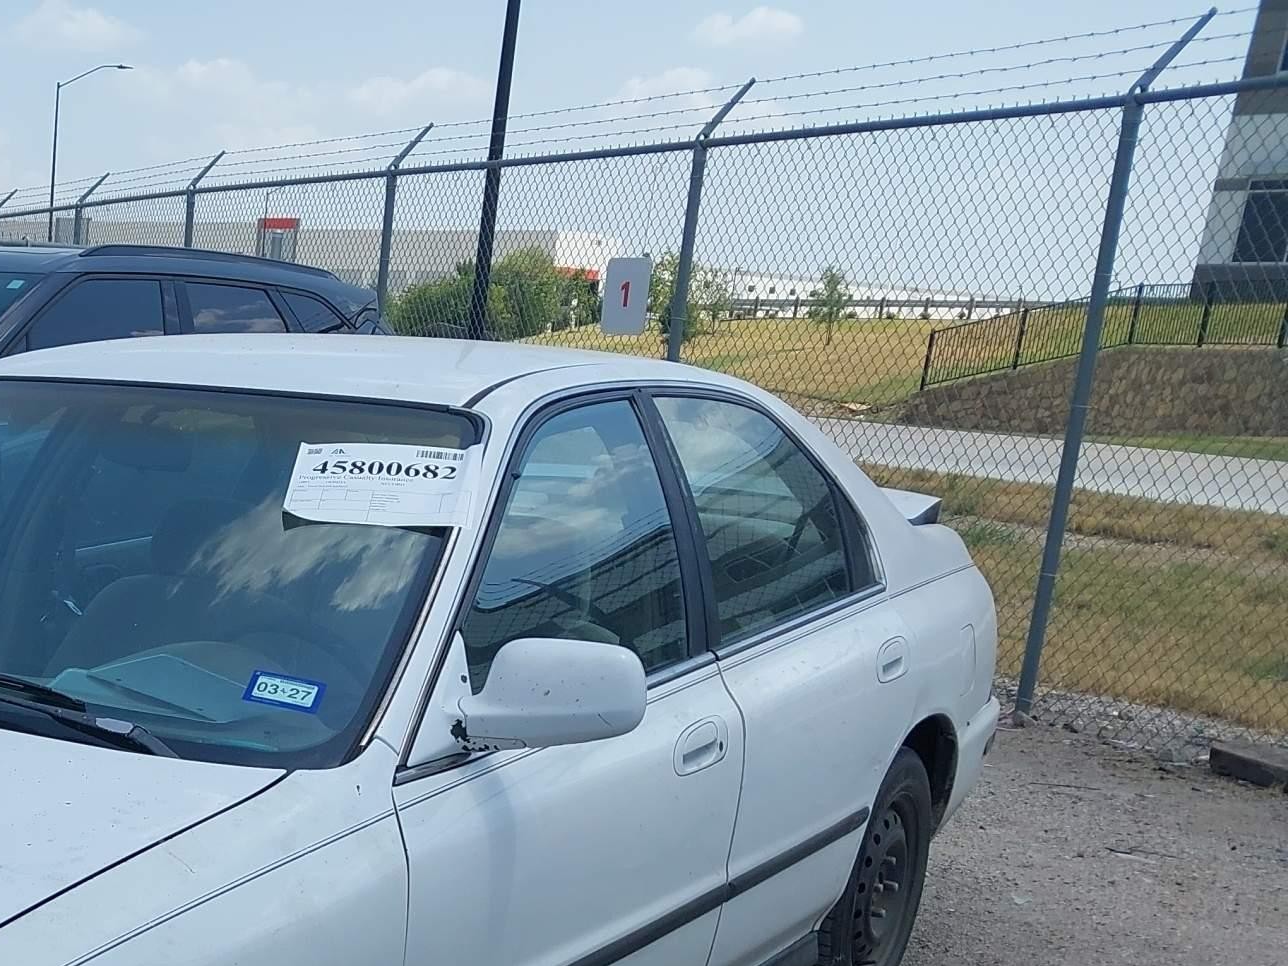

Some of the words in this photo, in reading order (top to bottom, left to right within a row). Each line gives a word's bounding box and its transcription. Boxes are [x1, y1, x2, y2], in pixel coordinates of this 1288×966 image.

[620, 281, 630, 308] 1
[312, 460, 457, 480] 45800682
[256, 681, 279, 695] 03
[287, 688, 312, 701] 27
